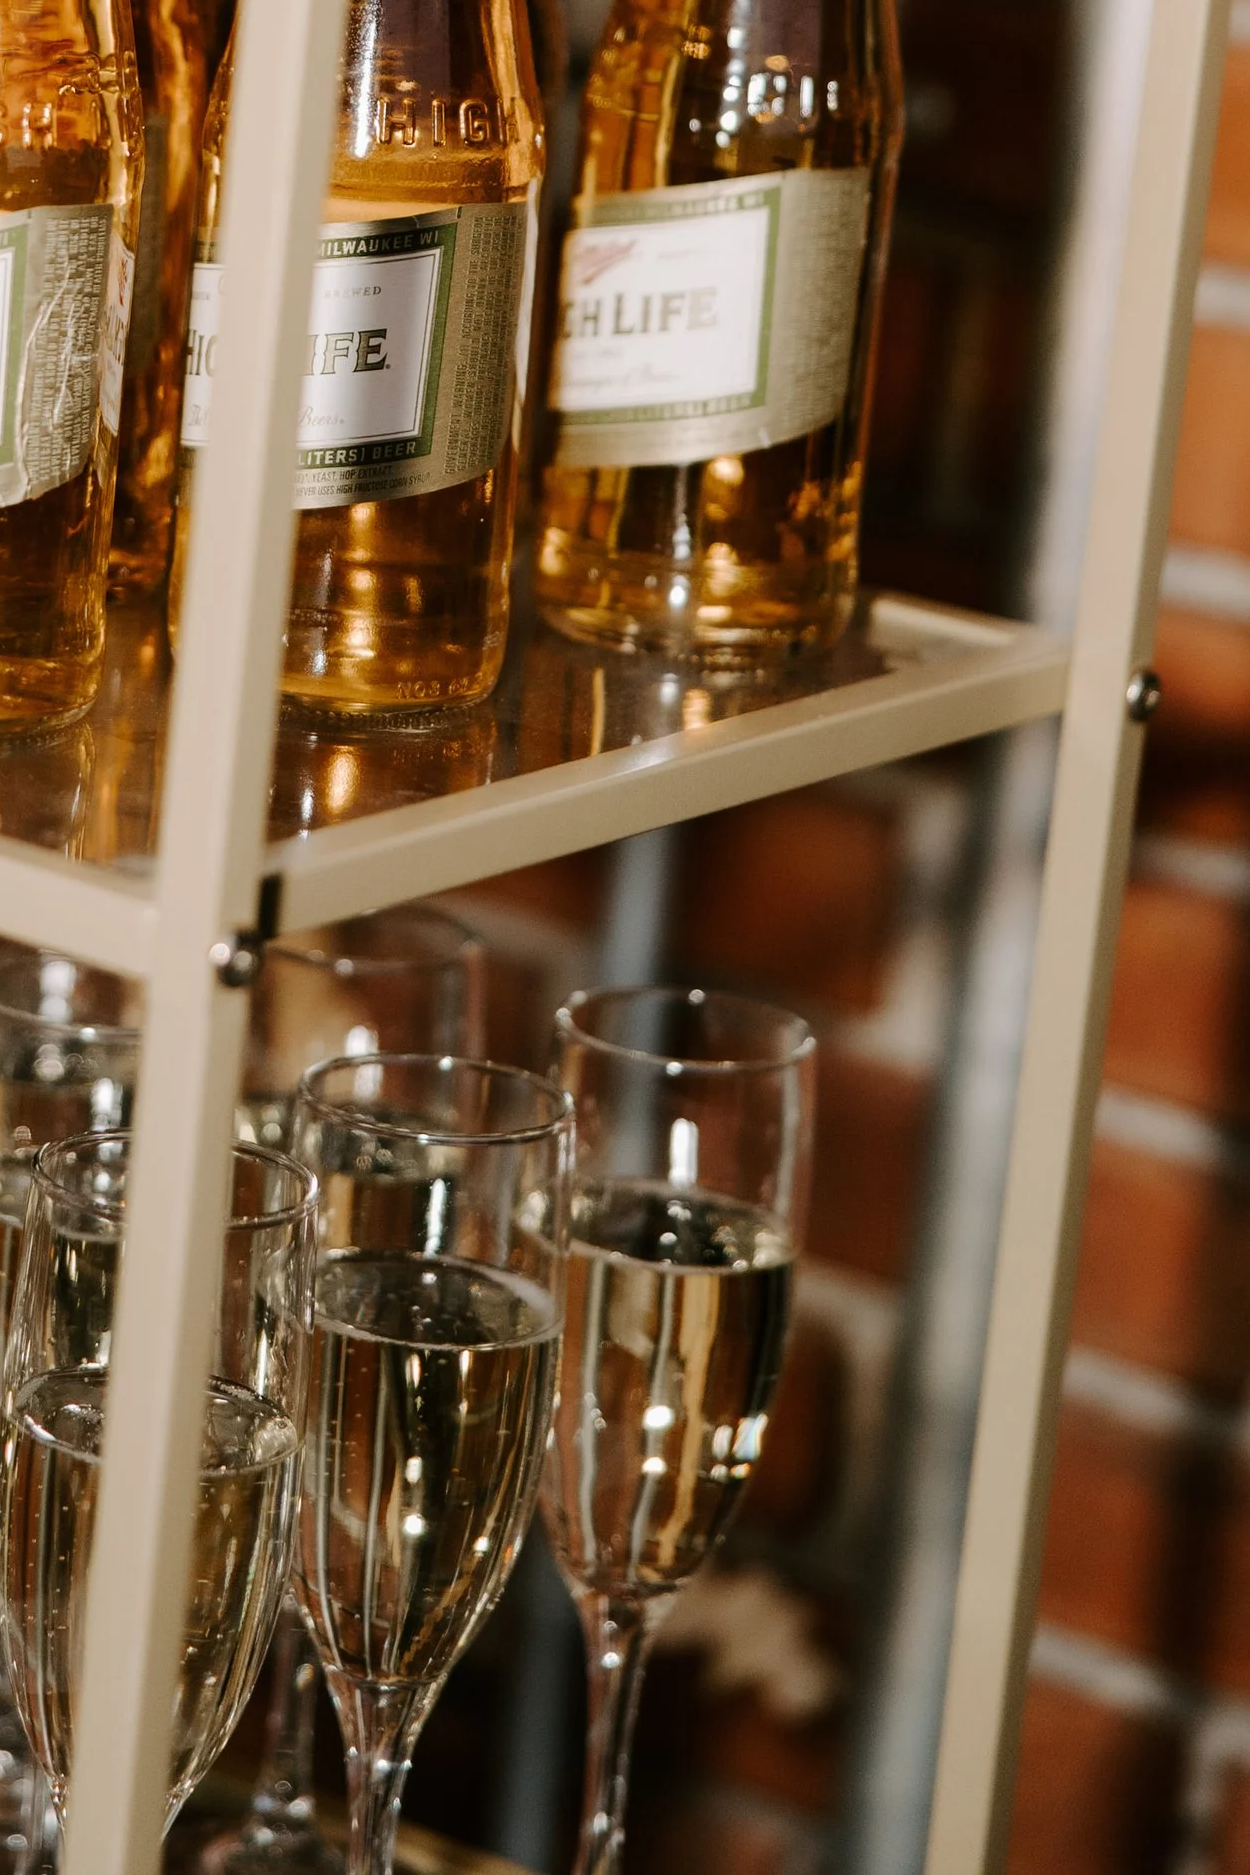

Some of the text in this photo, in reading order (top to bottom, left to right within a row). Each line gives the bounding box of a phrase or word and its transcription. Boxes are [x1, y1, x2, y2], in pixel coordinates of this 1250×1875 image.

[420, 230, 439, 246] WI
[469, 217, 483, 255] SURGEON
[467, 260, 478, 275] THE
[324, 285, 382, 299] BREWED
[461, 293, 475, 340] ACCORDING
[611, 286, 719, 336] LIFE
[306, 328, 388, 375] IFE
[451, 361, 468, 409] WARNING:
[298, 441, 416, 466] LITERS) BEER
[444, 413, 461, 474] GOVERNMENT
[339, 469, 356, 481] HOP
[358, 465, 393, 480] EXTRACT
[317, 484, 335, 496] USES
[336, 482, 353, 494] HIGH
